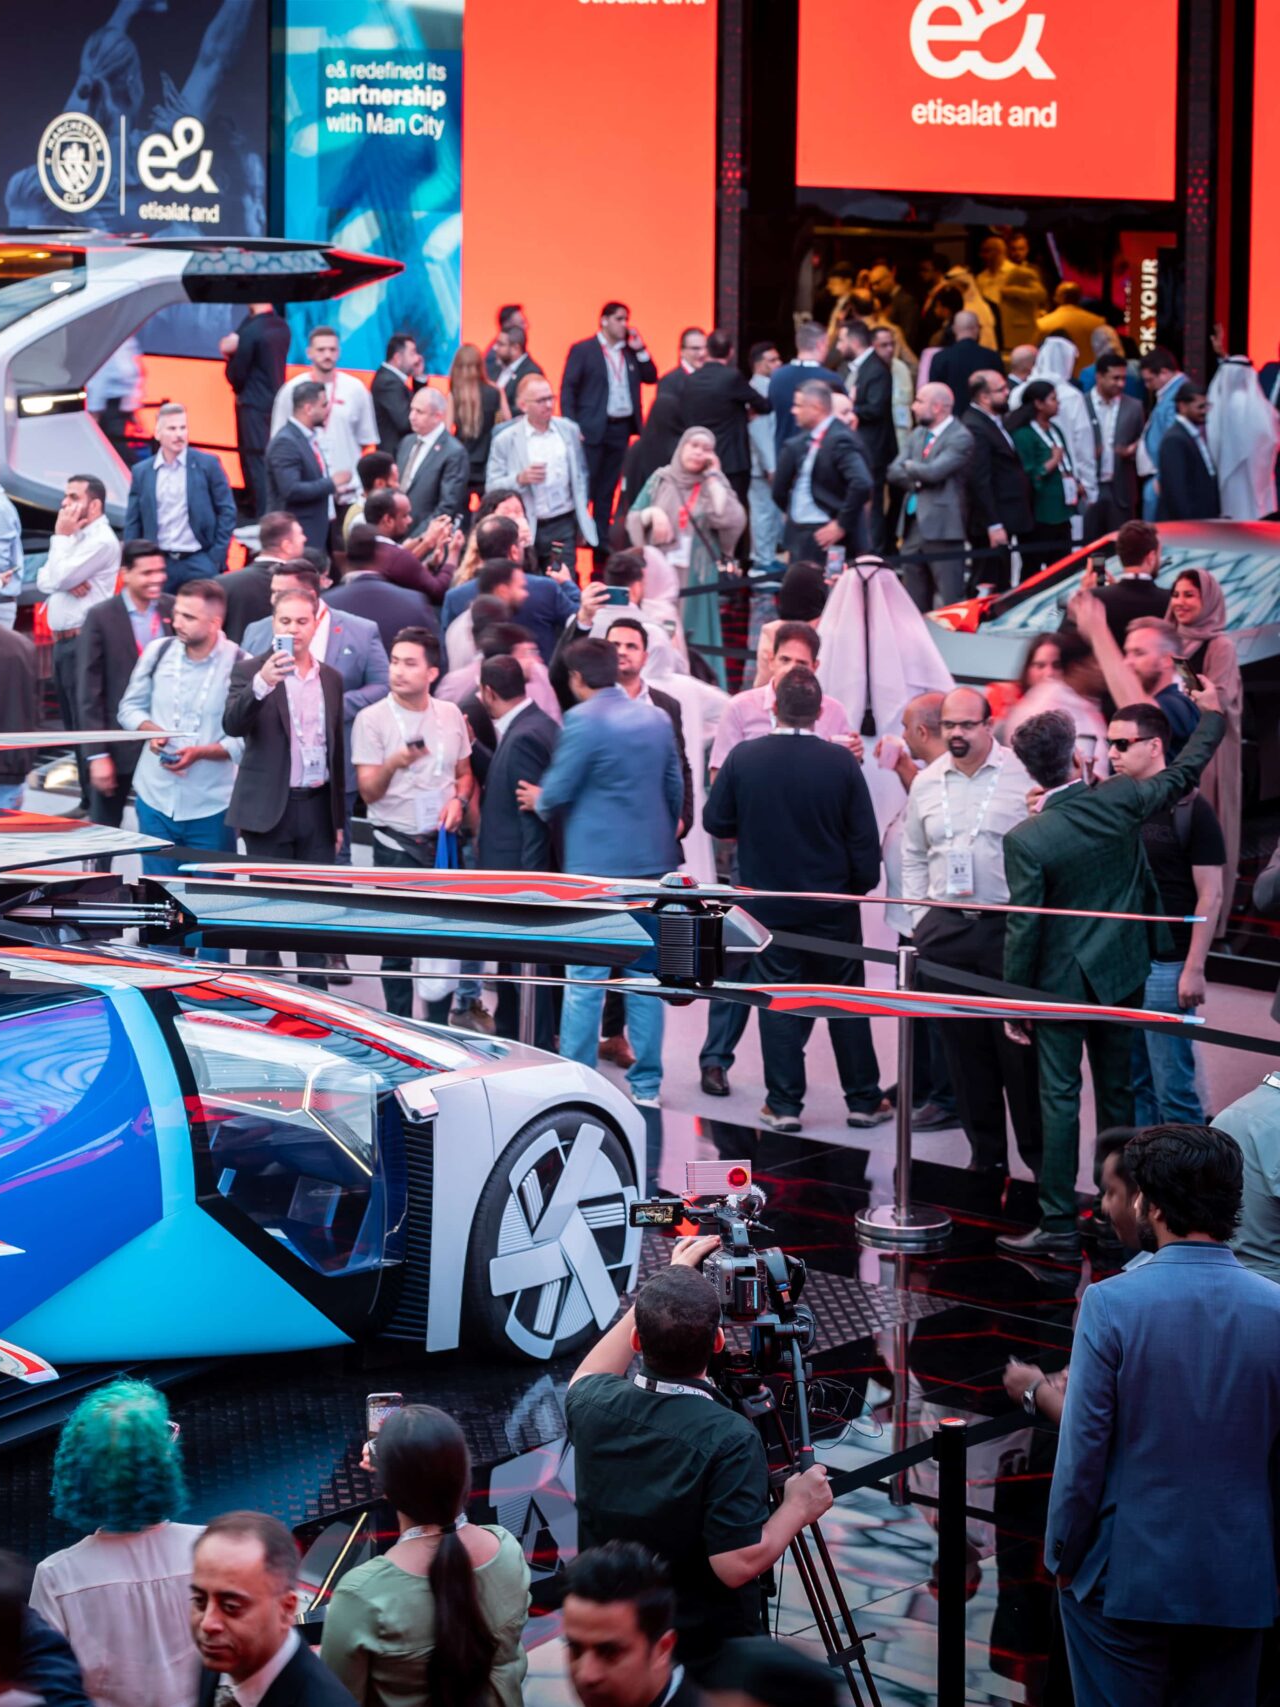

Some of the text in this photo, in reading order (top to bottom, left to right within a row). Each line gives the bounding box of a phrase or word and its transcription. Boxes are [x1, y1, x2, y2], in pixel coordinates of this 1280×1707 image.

[350, 61, 425, 80] redefined
[427, 62, 447, 82] its
[325, 84, 447, 112] partnership
[326, 112, 445, 141] with Man City
[911, 98, 1058, 129] etisalat and
[139, 201, 220, 224] etisalat and
[1140, 258, 1159, 321] YOUR
